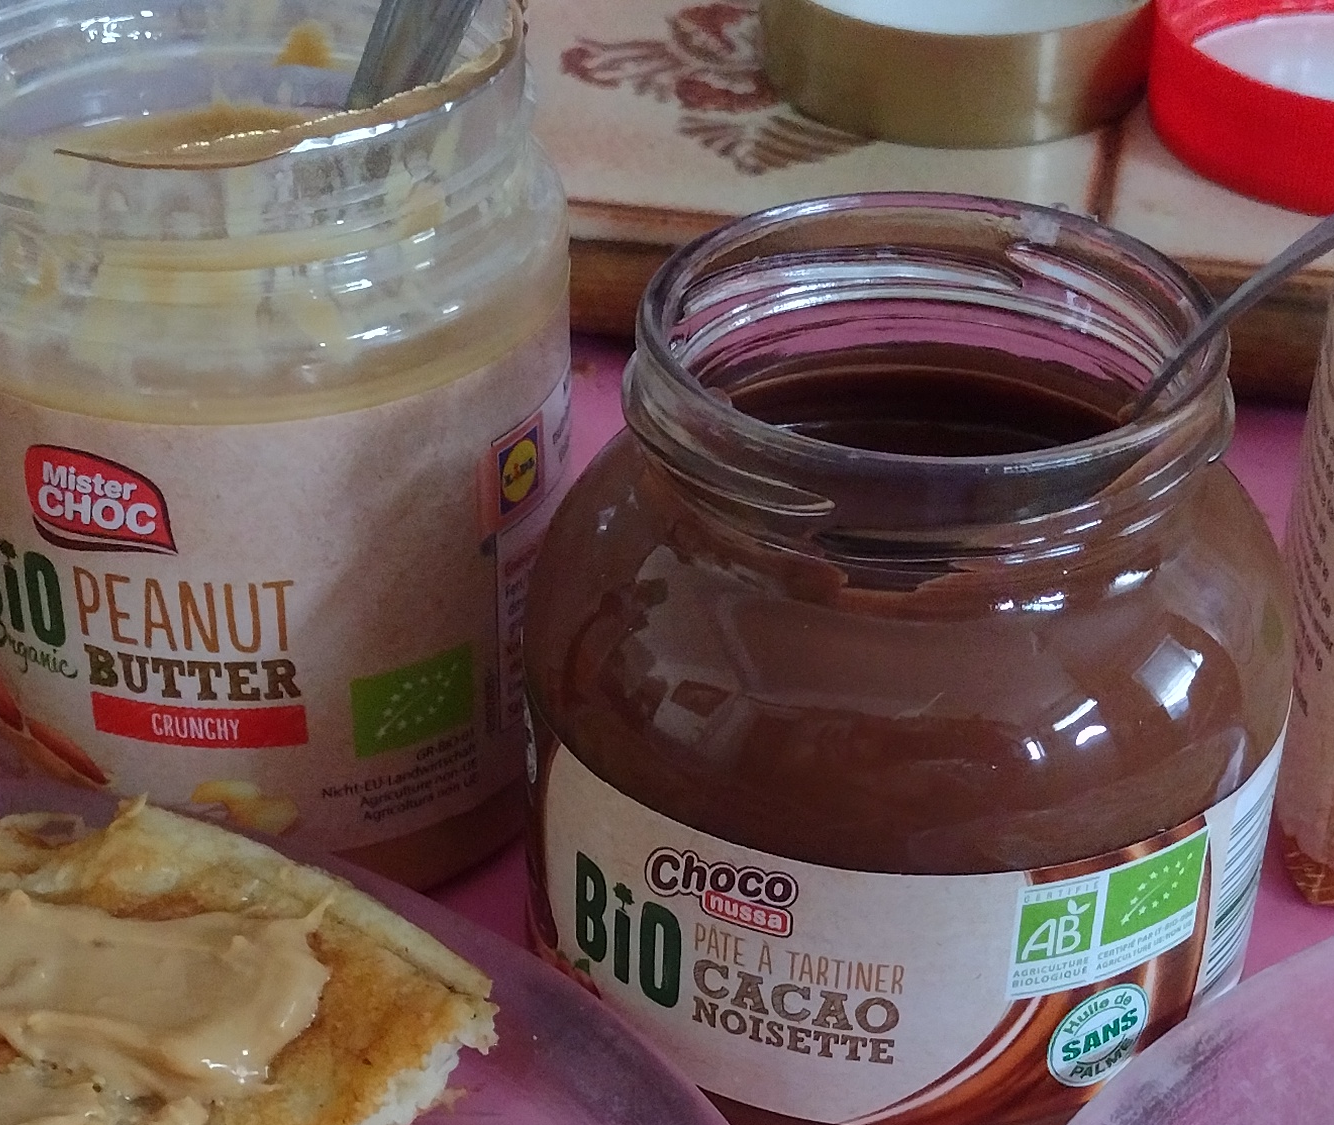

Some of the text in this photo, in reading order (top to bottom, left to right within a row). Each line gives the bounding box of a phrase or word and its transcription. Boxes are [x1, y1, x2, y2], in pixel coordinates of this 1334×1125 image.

[42, 460, 138, 501] Mister
[38, 484, 158, 535] CHOC
[72, 565, 295, 653] PEANUT
[84, 643, 303, 701] BUTTER
[151, 712, 240, 742] CRUNCHY
[650, 853, 794, 903] Choco
[709, 893, 784, 932] nussa
[694, 921, 906, 995] PÂTE À TARTINER
[1021, 914, 1082, 961] AB
[1095, 942, 1152, 971] AGRICULTURE
[1137, 931, 1154, 946] PAR
[1011, 965, 1088, 988] BIOLOGIQUE
[1012, 957, 1090, 978] AGRICULTURE
[693, 958, 901, 1034] CACAO
[1063, 991, 1133, 1035] Huile de
[692, 994, 896, 1065] NOISETTE
[1061, 1007, 1139, 1062] SANS
[1069, 1037, 1134, 1080] PALME
